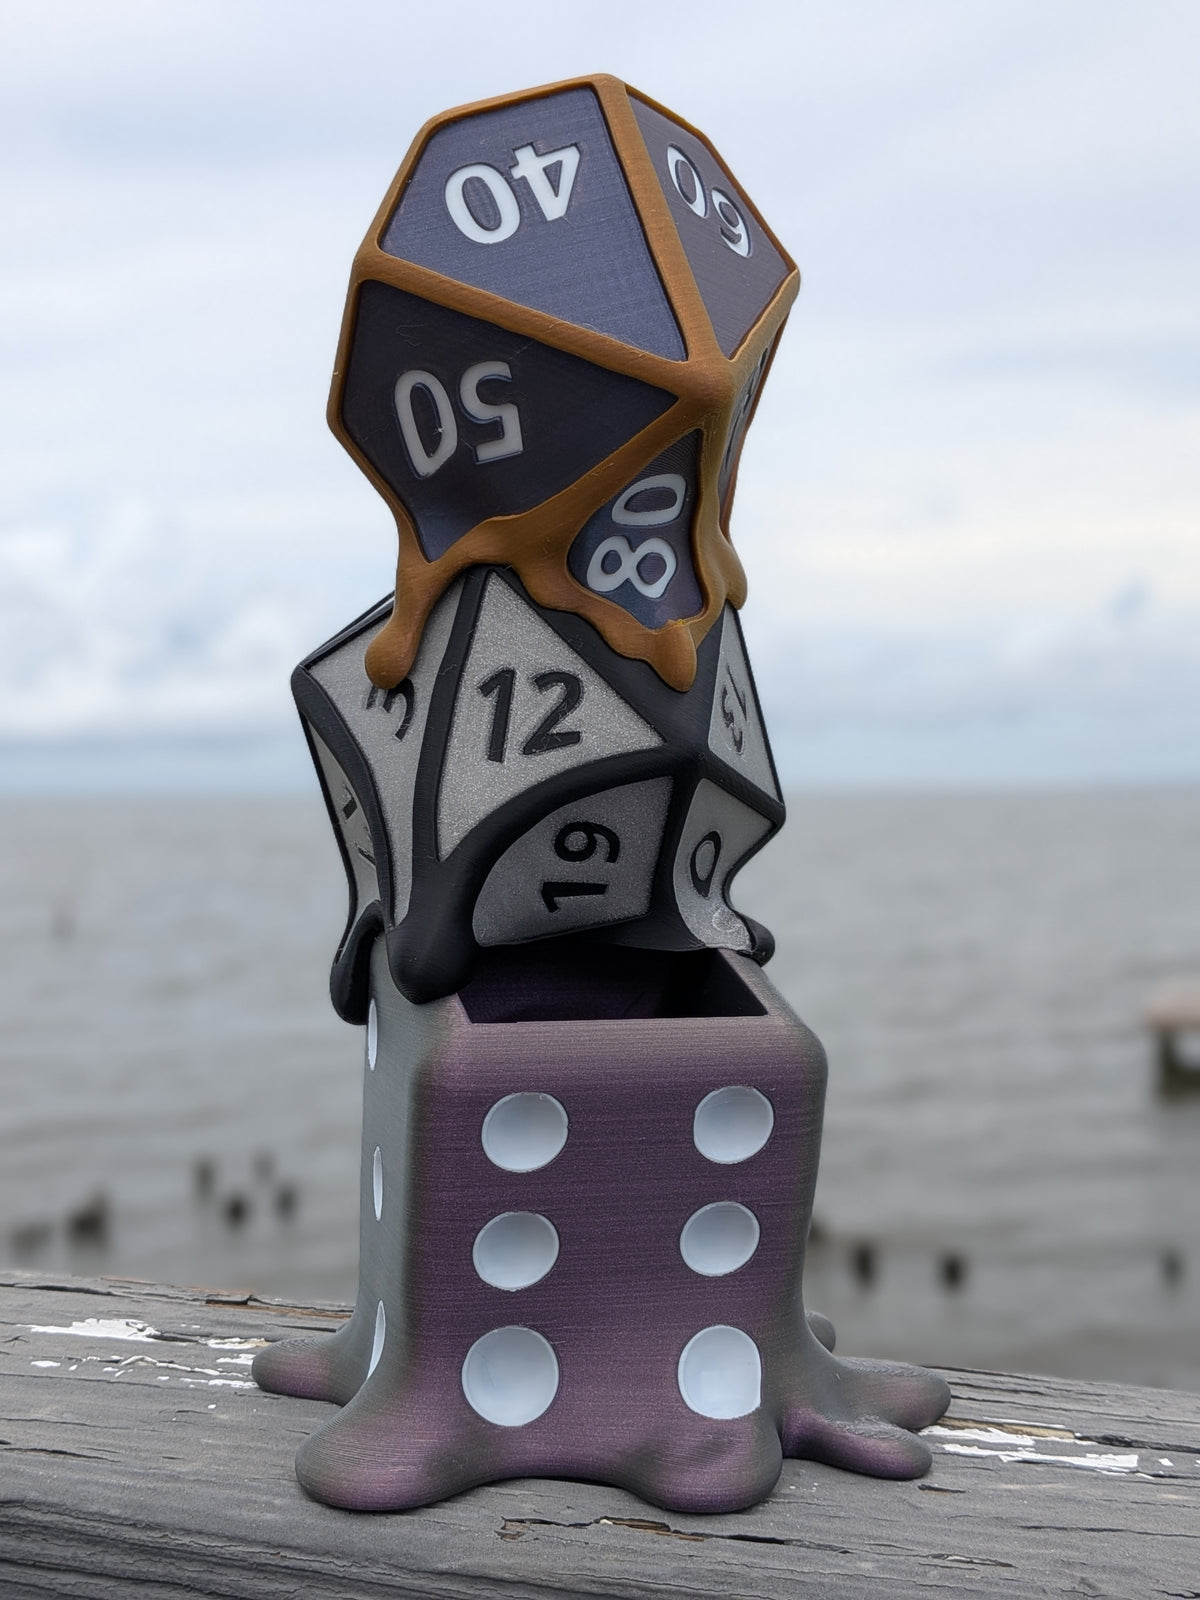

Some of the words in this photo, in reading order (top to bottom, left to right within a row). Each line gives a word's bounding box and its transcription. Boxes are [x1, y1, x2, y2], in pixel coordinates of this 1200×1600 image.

[444, 141, 582, 245] 40
[666, 143, 752, 259] 60
[394, 360, 524, 479] 50
[586, 472, 688, 599] 80
[478, 667, 584, 764] 12
[540, 820, 622, 913] 19
